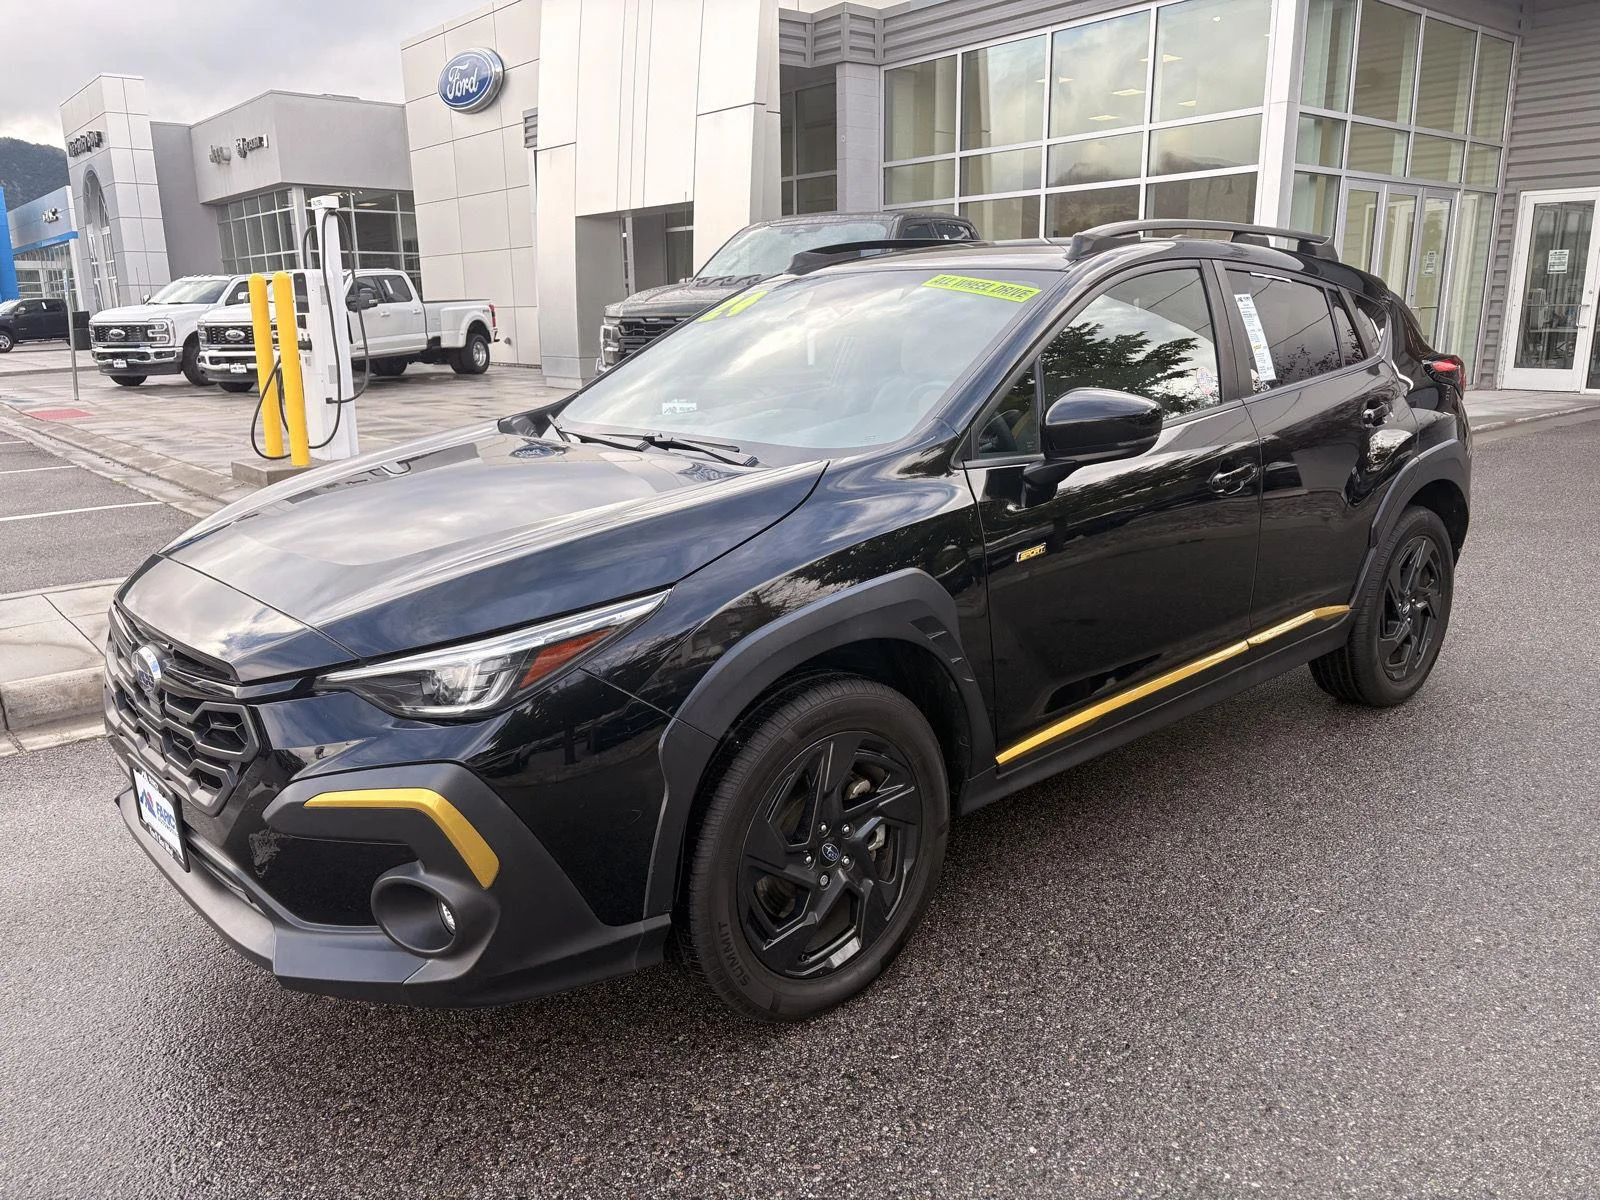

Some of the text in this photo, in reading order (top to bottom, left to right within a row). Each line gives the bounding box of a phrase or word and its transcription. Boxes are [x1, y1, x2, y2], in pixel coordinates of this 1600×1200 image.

[446, 63, 479, 100] Ford
[953, 279, 993, 291] WHEEL
[991, 284, 1034, 298] DRIVE
[1018, 545, 1045, 561] SPORT
[718, 921, 750, 986] SUMMIT
